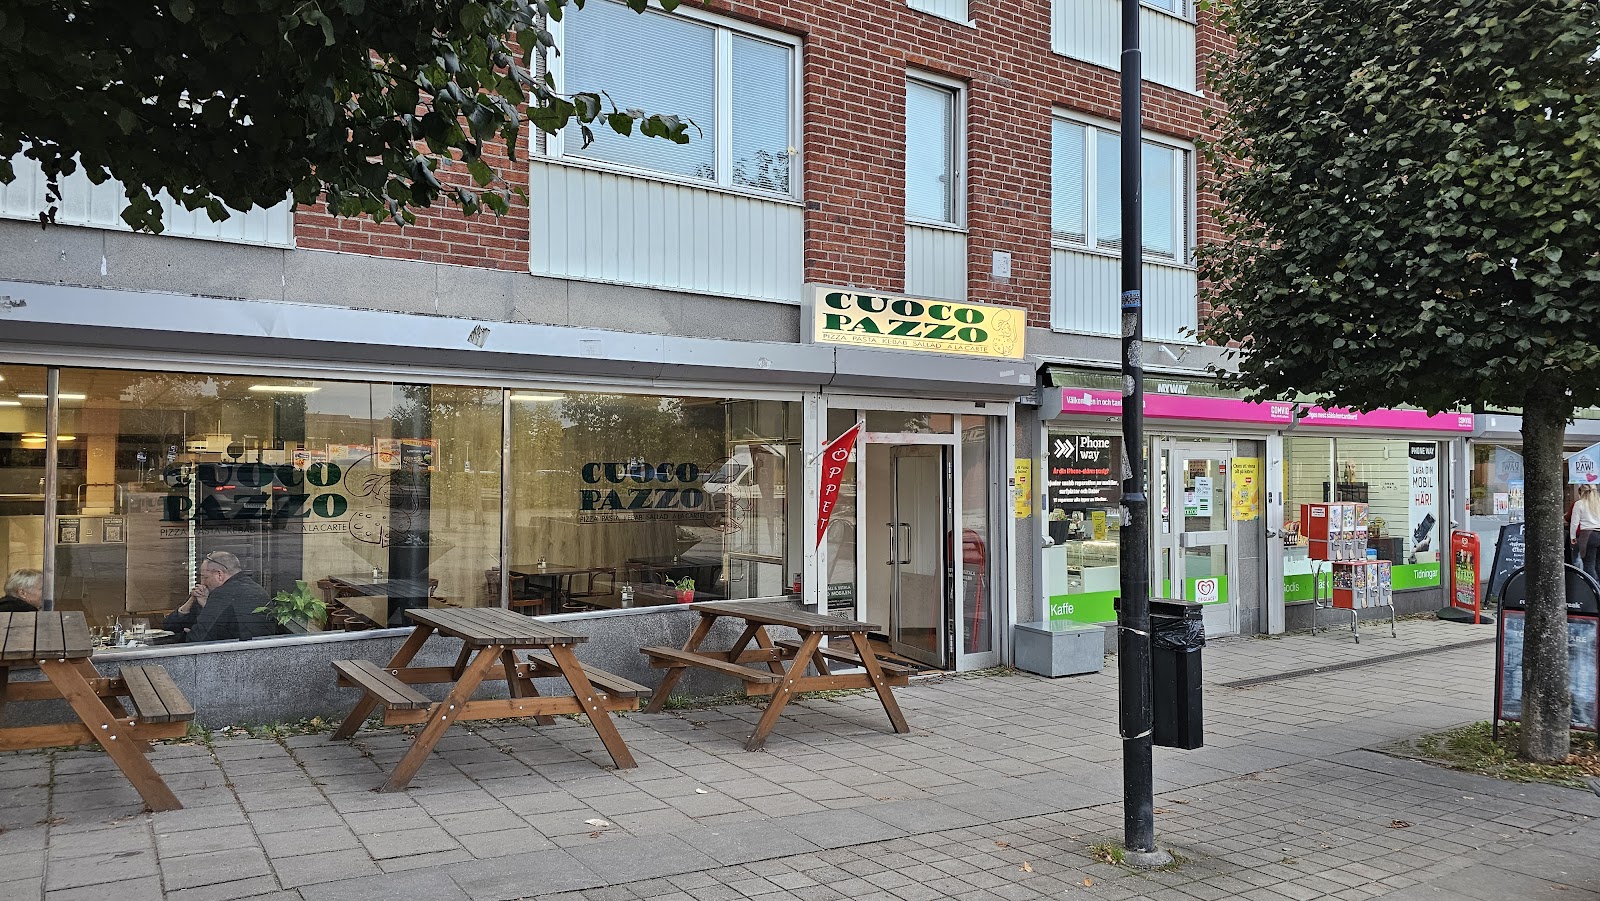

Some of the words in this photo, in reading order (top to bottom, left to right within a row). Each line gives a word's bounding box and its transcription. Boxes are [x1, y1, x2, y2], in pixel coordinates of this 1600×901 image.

[825, 292, 985, 324] CUOCO
[822, 312, 988, 343] PAZZO
[822, 333, 847, 341] PIZZA
[912, 341, 942, 349] SALLAD
[1157, 383, 1189, 395] MYWAY
[1066, 396, 1096, 406] Välkoen
[1080, 436, 1110, 448] Phone
[1080, 450, 1100, 462] way
[581, 462, 700, 484] CUOCO
[1575, 461, 1594, 472] RAW!
[162, 462, 342, 488] CUOCO
[1412, 476, 1434, 488] MOBIL
[820, 447, 848, 529] ÖPPET
[579, 487, 704, 511] PAZZO
[1415, 490, 1432, 506] HÄR!
[159, 493, 348, 522] PAZZO
[580, 515, 598, 523] PIZZA
[646, 513, 669, 521] SALLAD
[160, 528, 188, 537] PIZZA
[320, 523, 347, 532] CARTE
[1413, 569, 1438, 580] Tidningar
[1050, 602, 1075, 617] Kaffe
